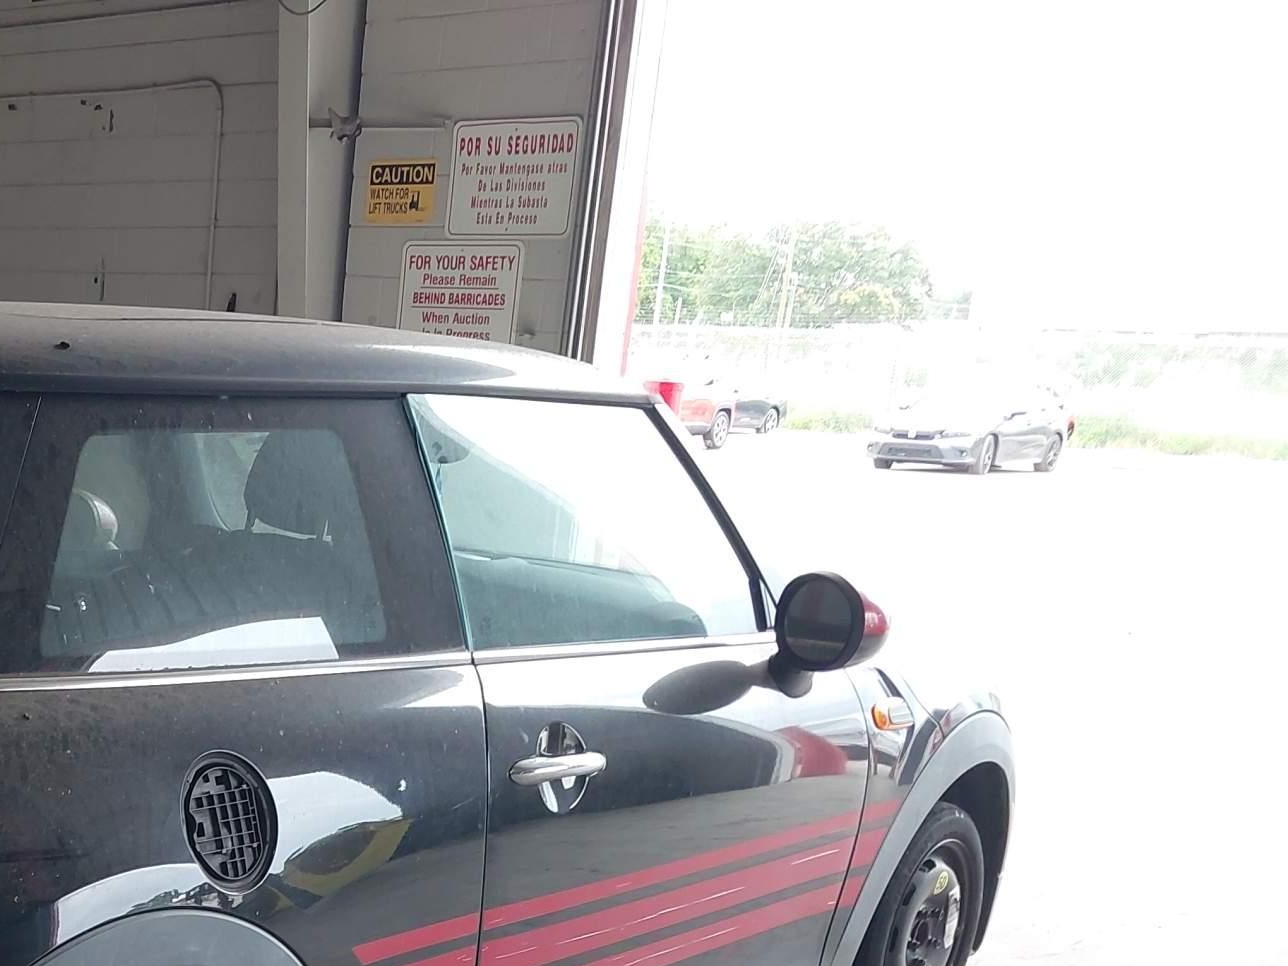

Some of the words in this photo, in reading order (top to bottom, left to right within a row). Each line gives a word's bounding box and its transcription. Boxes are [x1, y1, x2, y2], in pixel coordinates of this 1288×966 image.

[459, 137, 481, 156] POR
[487, 136, 501, 156] SU
[507, 133, 574, 155] SEGURIDAD
[372, 166, 434, 183] CAUTION
[461, 163, 473, 176] Por
[476, 162, 496, 175] Favor
[499, 162, 543, 177] Mantengase
[548, 162, 567, 174] atras
[478, 179, 487, 192] De
[490, 180, 502, 192] Las
[506, 179, 545, 192] Divisiones
[370, 187, 394, 200] WATCH
[395, 187, 409, 199] FOR
[369, 202, 382, 214] LIFT
[383, 201, 408, 214] TRUCKS
[471, 196, 502, 208] Mientras
[506, 196, 514, 208] La
[518, 195, 548, 208] Subasta
[476, 212, 492, 224] Esta
[495, 212, 504, 224] En
[507, 212, 537, 224] Proceso
[409, 255, 431, 270] FOR
[435, 255, 466, 271] YOUR
[469, 255, 516, 271] SAFETY
[422, 273, 455, 286] Please
[458, 274, 496, 286] Remain
[412, 292, 446, 304] BEHIND
[448, 293, 506, 306] BARRICADES
[422, 311, 449, 324] When
[452, 312, 490, 325] Auction
